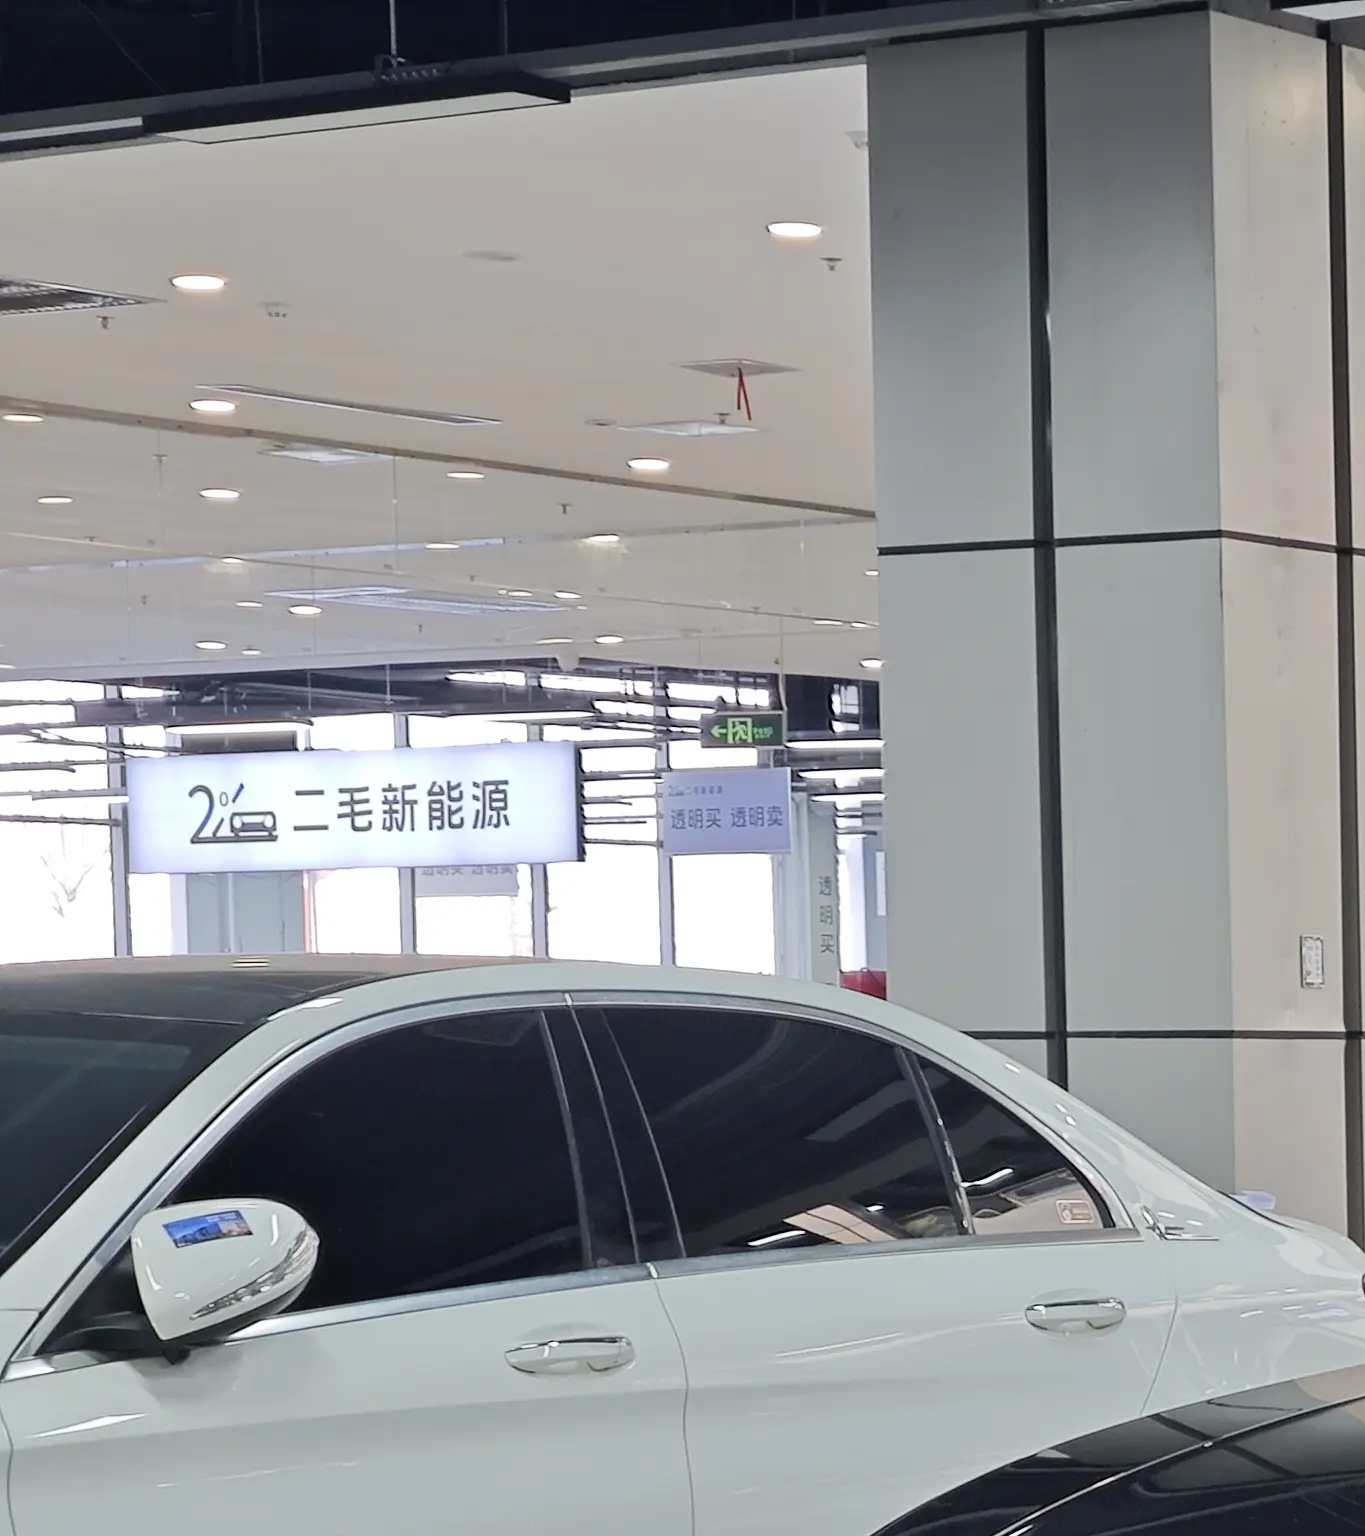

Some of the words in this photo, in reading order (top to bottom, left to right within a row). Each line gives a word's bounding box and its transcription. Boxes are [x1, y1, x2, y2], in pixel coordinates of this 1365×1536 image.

[293, 780, 510, 832] 二毛新能源
[670, 808, 722, 830] 透明买
[730, 806, 784, 828] 透明卖
[819, 876, 834, 954] 透明买
